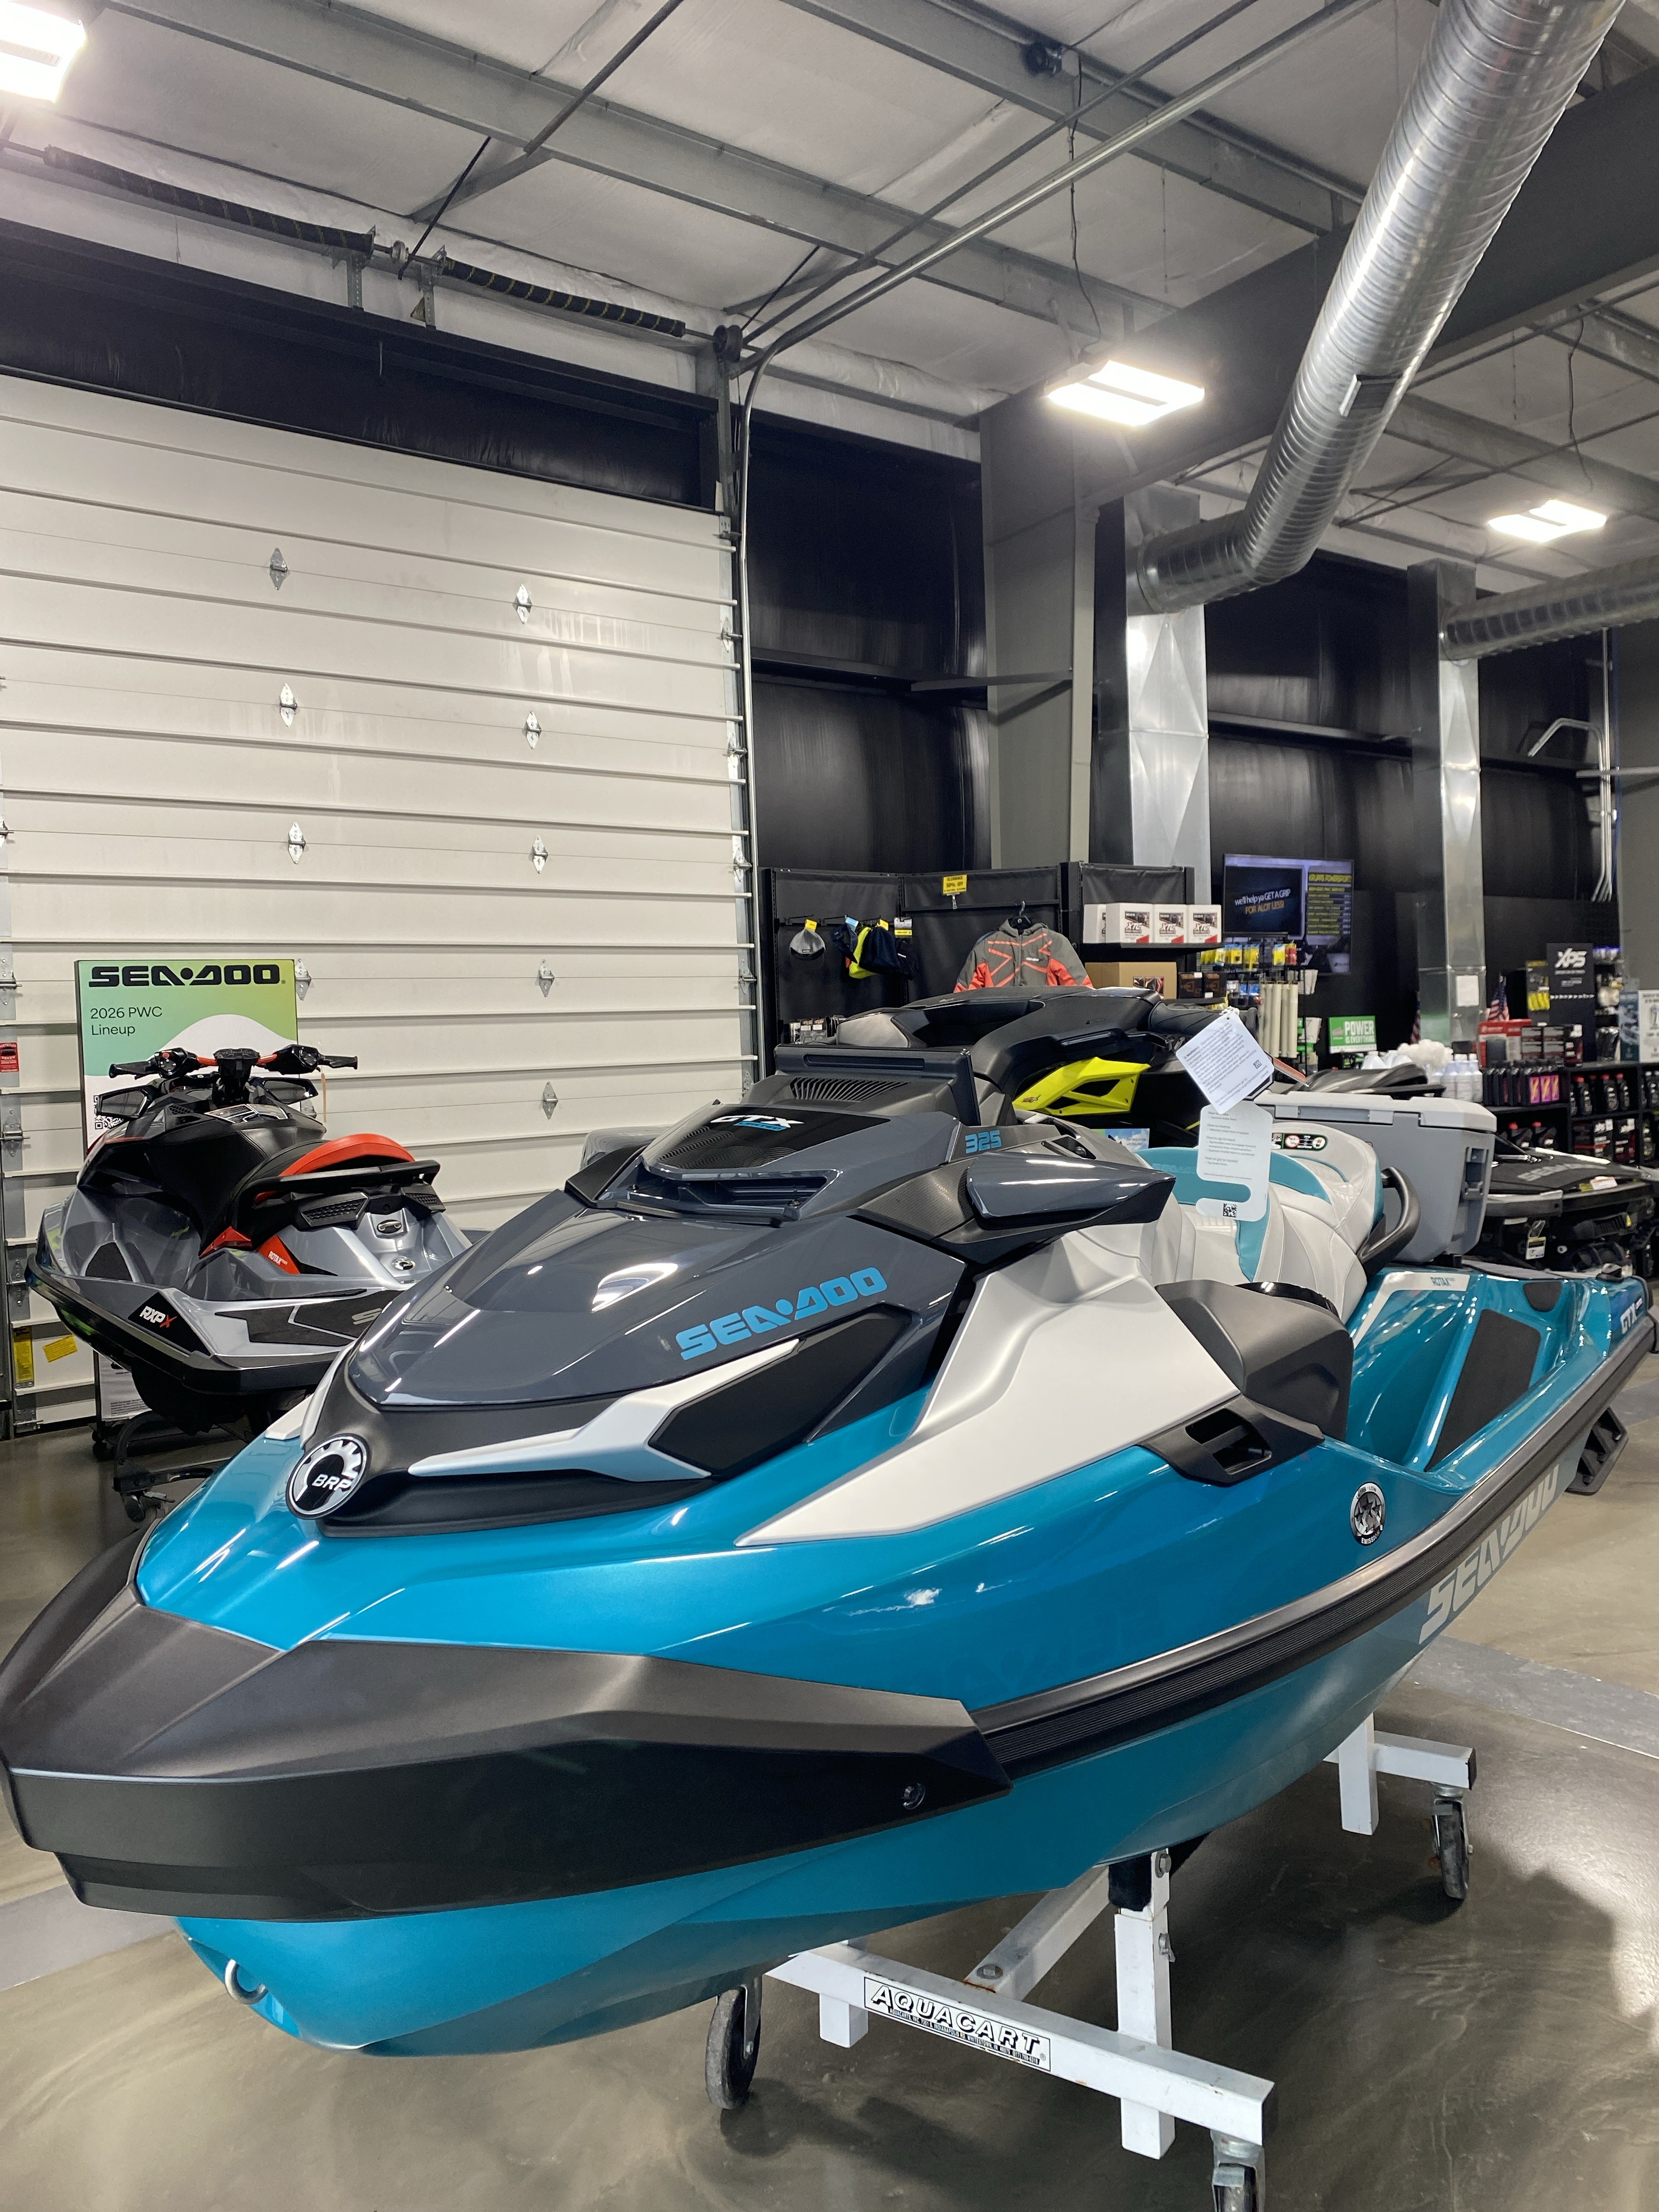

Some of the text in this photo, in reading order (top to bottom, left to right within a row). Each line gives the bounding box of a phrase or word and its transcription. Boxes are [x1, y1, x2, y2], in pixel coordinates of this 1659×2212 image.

[1555, 947, 1587, 968] XPS
[91, 1006, 162, 1019] 2026 PWC
[91, 1024, 136, 1036] Lineup
[1345, 1020, 1374, 1036] POWER
[710, 1115, 805, 1128] GTX
[965, 1130, 1002, 1154] 325
[268, 1250, 283, 1265] ROTAX
[312, 1474, 353, 1491] BRP
[871, 1985, 1040, 2054] AQUACART
